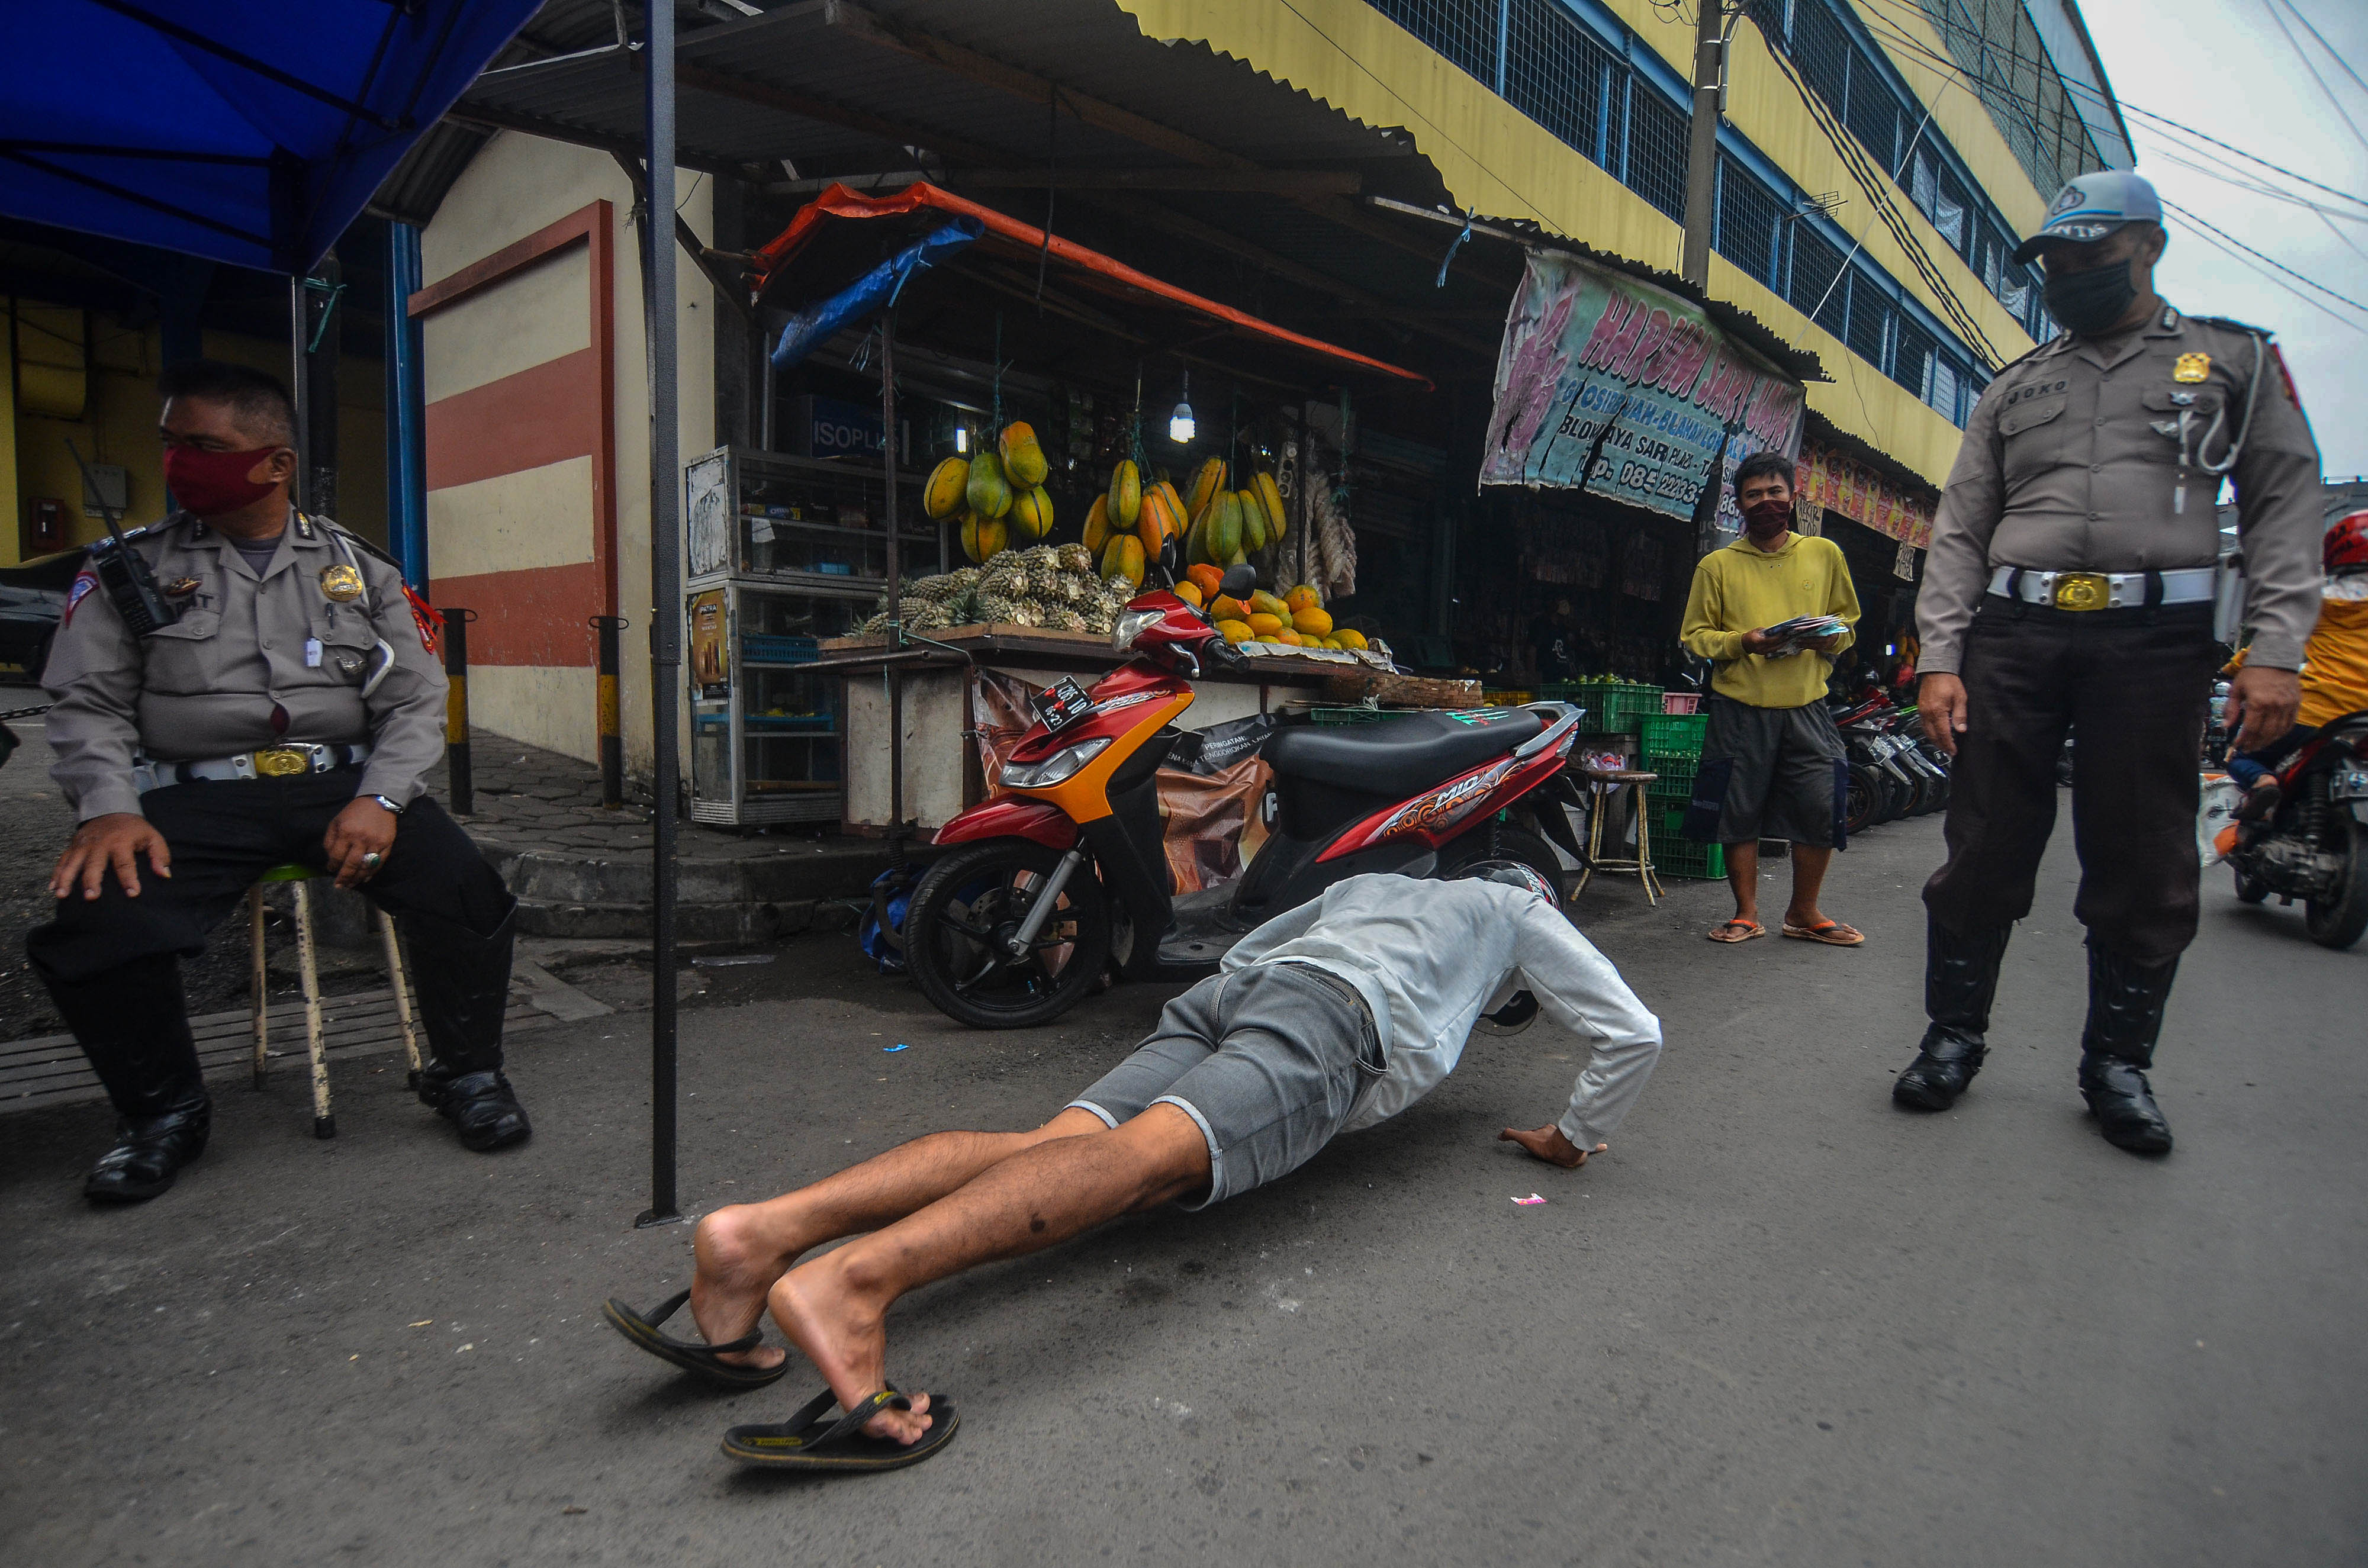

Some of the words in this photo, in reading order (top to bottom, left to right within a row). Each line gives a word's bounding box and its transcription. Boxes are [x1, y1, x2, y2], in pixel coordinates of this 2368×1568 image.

[1577, 289, 1713, 403] HARUM
[1694, 340, 1757, 425] SARI
[2008, 381, 2065, 404] JOKO
[1719, 492, 1741, 519] 86
[1204, 735, 1247, 751] PERINGATAN:
[1433, 775, 1479, 809] MIO
